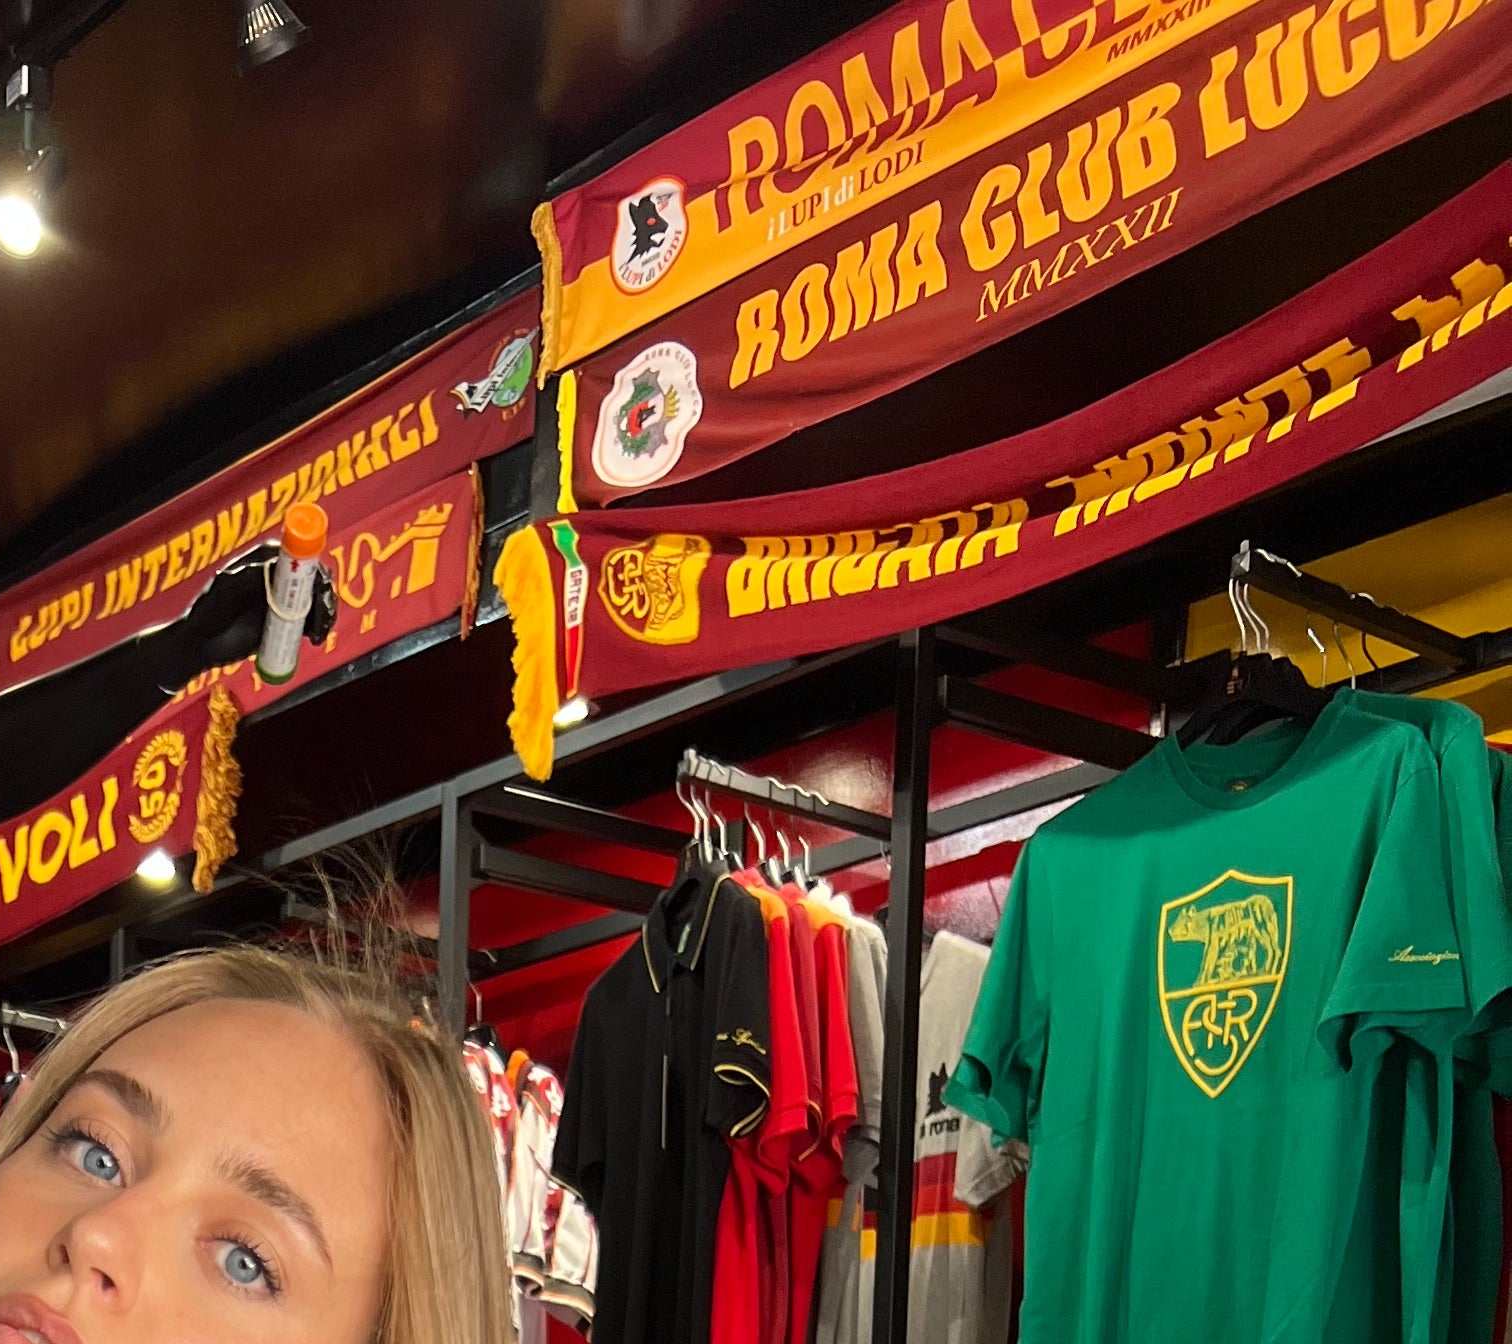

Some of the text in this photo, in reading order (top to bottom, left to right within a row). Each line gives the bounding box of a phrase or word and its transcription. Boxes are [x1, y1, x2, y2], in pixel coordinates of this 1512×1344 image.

[728, 200, 947, 389] ROMA
[960, 81, 1181, 271] CLUB
[858, 140, 925, 195] LODI
[975, 187, 1184, 323] MMXXII
